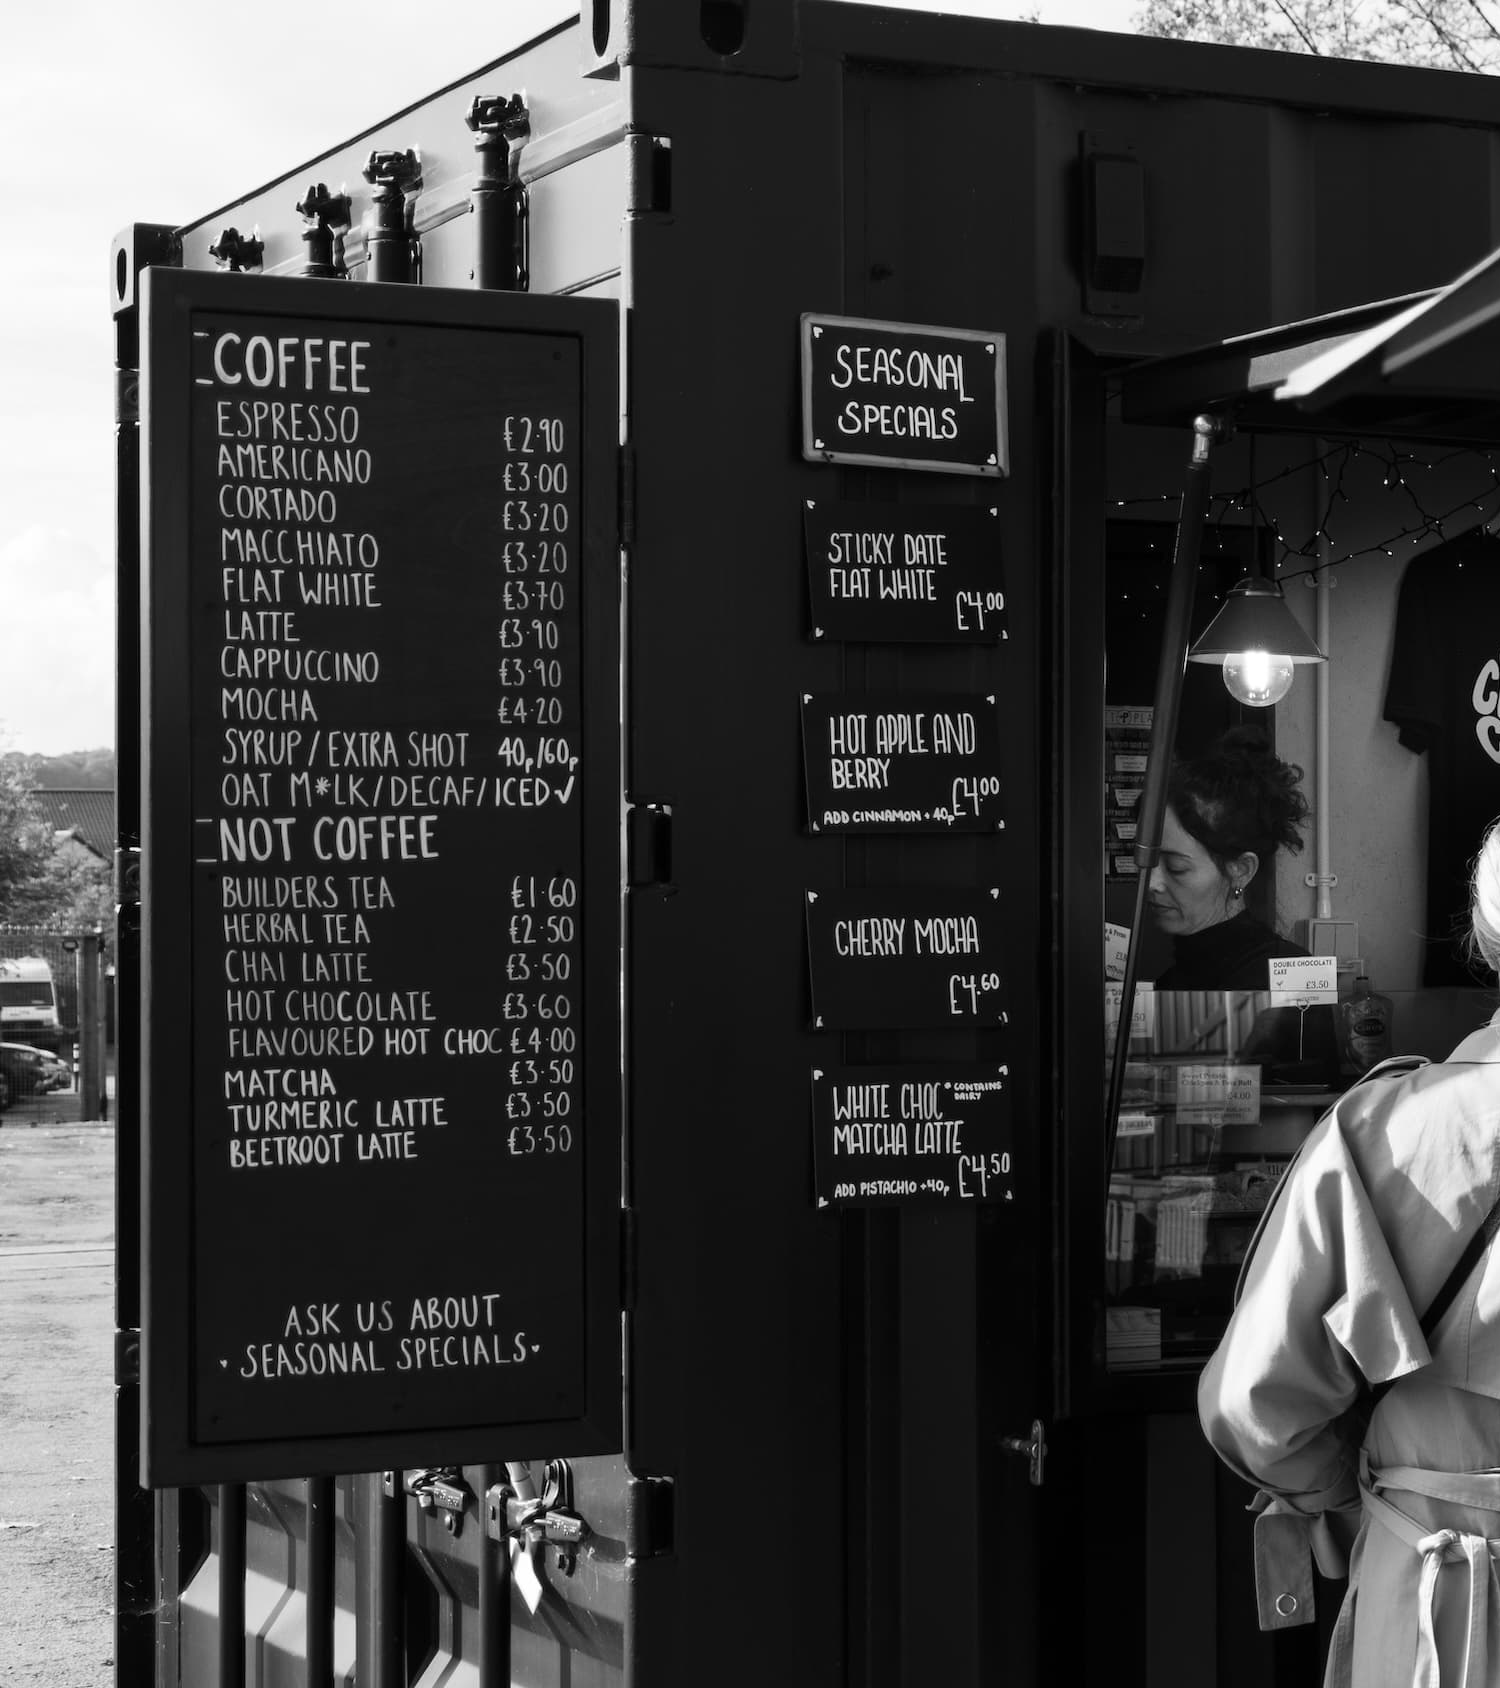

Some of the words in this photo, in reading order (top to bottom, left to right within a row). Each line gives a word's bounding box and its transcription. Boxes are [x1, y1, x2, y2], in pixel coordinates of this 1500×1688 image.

[213, 332, 371, 394] COFFEE
[830, 344, 975, 403] SEASONAL
[216, 400, 359, 444] ESPRESSO
[503, 416, 564, 454] £2.90
[837, 400, 958, 440] SPECIALS
[217, 442, 372, 484] AMERICANO
[502, 461, 568, 494] £3.00
[218, 483, 337, 523] CORTADO
[501, 500, 569, 533] £3.20
[221, 527, 379, 569] MACCHIATO
[501, 541, 567, 574] £3.20
[827, 532, 895, 565] STICKY
[903, 533, 948, 566] DATE
[222, 567, 285, 603] FLAT
[298, 571, 382, 608] WHITE
[502, 580, 565, 611] £3.70
[829, 567, 872, 599] FLAT
[878, 567, 937, 601] WHITE
[225, 609, 301, 642] LATTE
[498, 618, 559, 650] £3.90
[955, 590, 1005, 631] £4.00
[220, 645, 380, 683] CAPPUCCINO
[498, 657, 562, 688] £3.90
[221, 687, 318, 722] MOCHA
[497, 696, 563, 725] £4.20
[407, 730, 470, 768] SHOT
[829, 713, 868, 756] HOT
[875, 713, 929, 755] APPLE
[932, 712, 976, 756] AND
[221, 772, 273, 807] OAT
[830, 756, 891, 790] BERRY
[952, 776, 1000, 817] £4.00
[219, 817, 297, 862] NOT
[313, 814, 440, 861] COFFEE
[823, 811, 850, 826] ADD
[852, 809, 922, 824] CINNAMON
[222, 875, 339, 909] BUILDERS
[348, 875, 396, 910] TEA
[510, 875, 577, 909] £1.60
[223, 912, 314, 945] HERBAL
[321, 913, 371, 945] TEA
[508, 913, 575, 945] £2.50
[834, 917, 906, 957] CHERRY
[913, 915, 980, 955] MOCHA
[224, 949, 286, 983] CHAI
[302, 951, 373, 983] LATTE
[505, 952, 571, 981] £3.50
[226, 988, 276, 1022] HOT
[285, 989, 437, 1023] CHOCOLATE
[502, 992, 571, 1020] £3.60
[949, 972, 1000, 1015] £4.60
[228, 1025, 375, 1059] FLAVOURED
[384, 1027, 431, 1057] HOT
[443, 1027, 503, 1056] CHOC
[509, 1026, 576, 1055] £4.00
[224, 1067, 337, 1100] MATCHA
[508, 1058, 574, 1086] £3.50
[954, 1092, 981, 1100] DAIRY
[226, 1098, 359, 1133] TURMERIC
[375, 1096, 449, 1128] LATTE
[504, 1091, 571, 1120] £3.50
[832, 1083, 891, 1121] WHITE
[900, 1081, 944, 1121] CHOC
[229, 1133, 345, 1169] BEETROOT
[357, 1130, 419, 1161] LATTE
[506, 1124, 572, 1156] £3.50
[833, 1122, 908, 1156] MATCHA
[914, 1119, 965, 1155] LATTE
[835, 1183, 856, 1198] ADD
[861, 1180, 917, 1195] PISTACHIO
[959, 1152, 1010, 1198] £4.50
[284, 1303, 341, 1338] ASK
[356, 1300, 394, 1333] US
[409, 1293, 501, 1331] ABOUT
[240, 1340, 386, 1378] SEASONAL
[396, 1331, 527, 1370] SPECIALS
